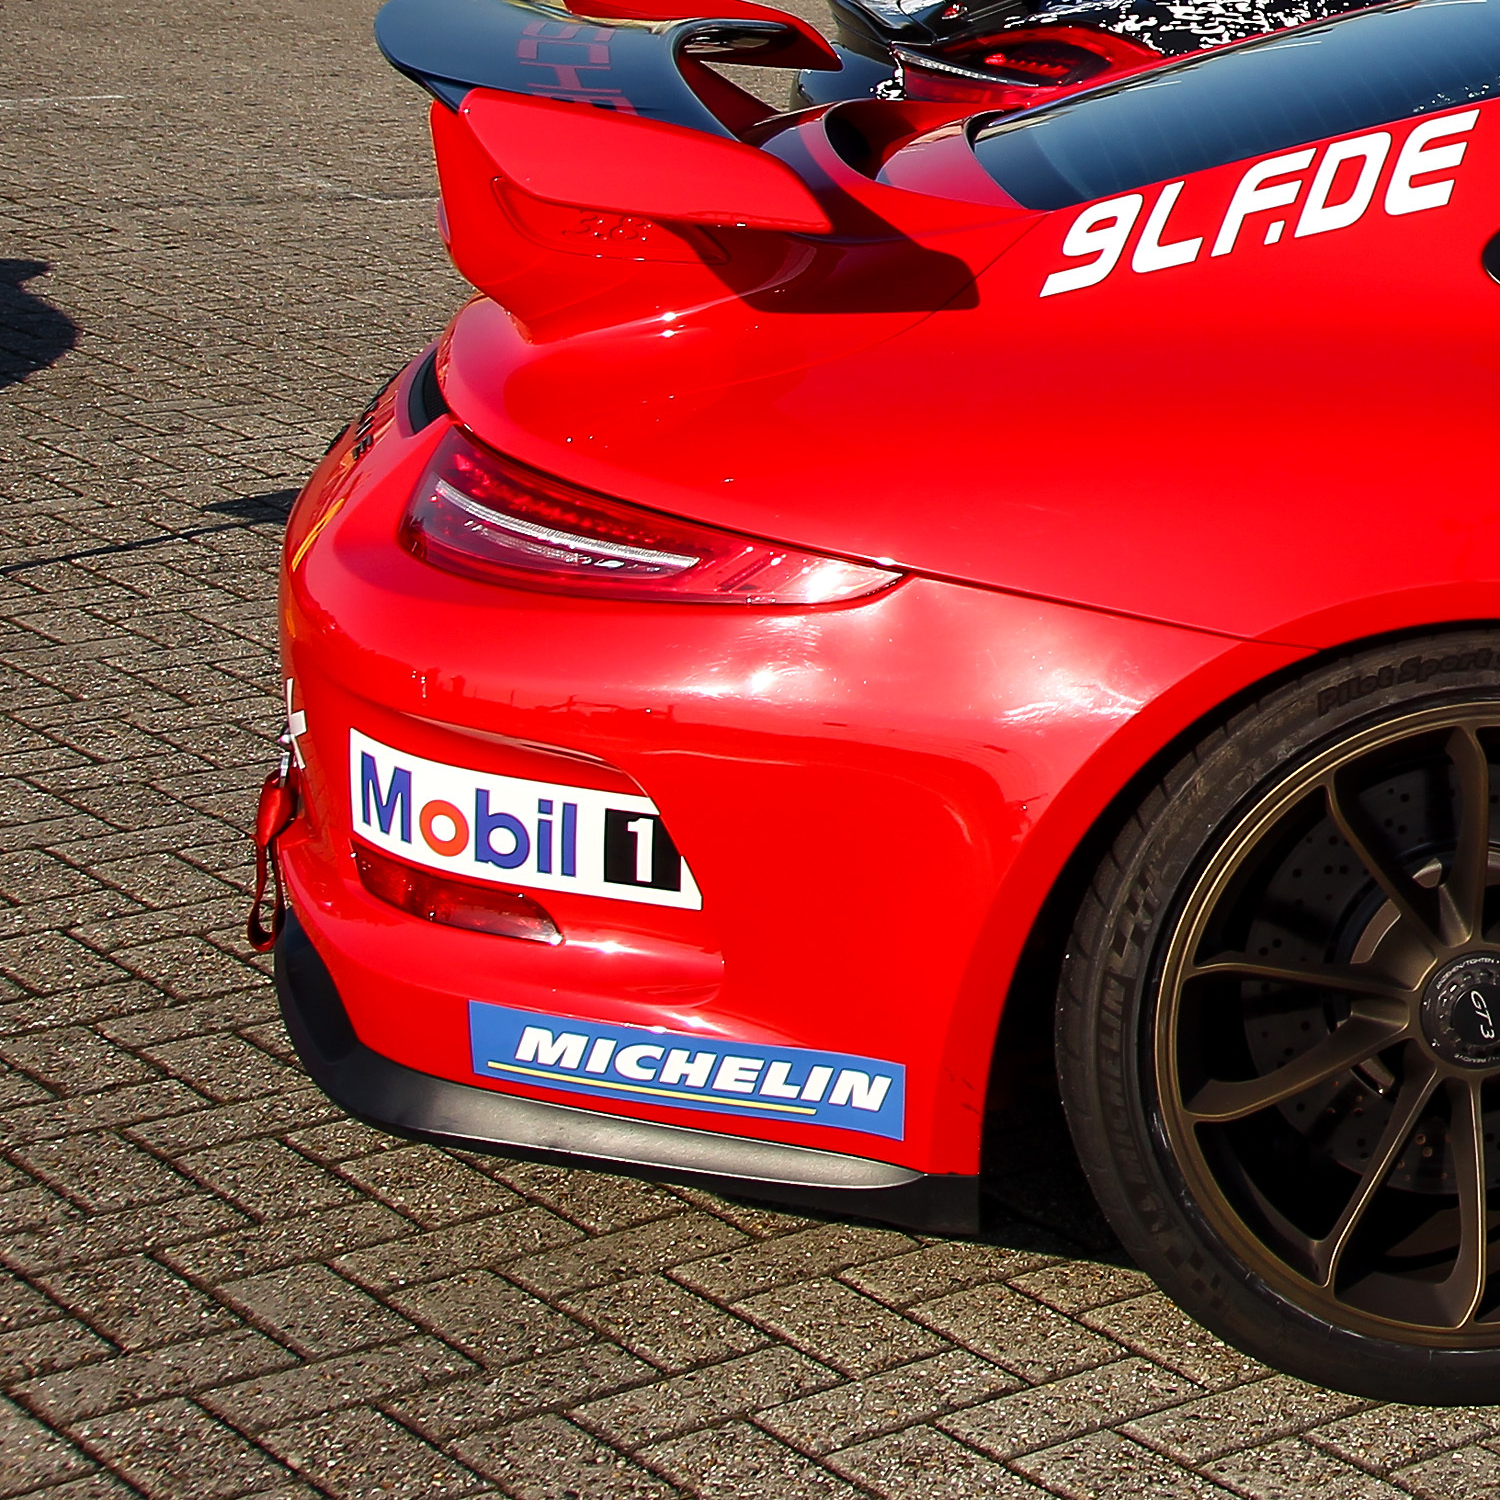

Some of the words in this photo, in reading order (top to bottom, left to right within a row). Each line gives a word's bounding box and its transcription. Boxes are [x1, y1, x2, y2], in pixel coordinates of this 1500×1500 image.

[1316, 664, 1396, 717] Pilot
[1398, 647, 1494, 684] Sport
[361, 749, 578, 879] Mobil
[626, 817, 655, 884] 1
[1470, 989, 1495, 1040] GT3
[514, 1026, 892, 1112] MICHELIN
